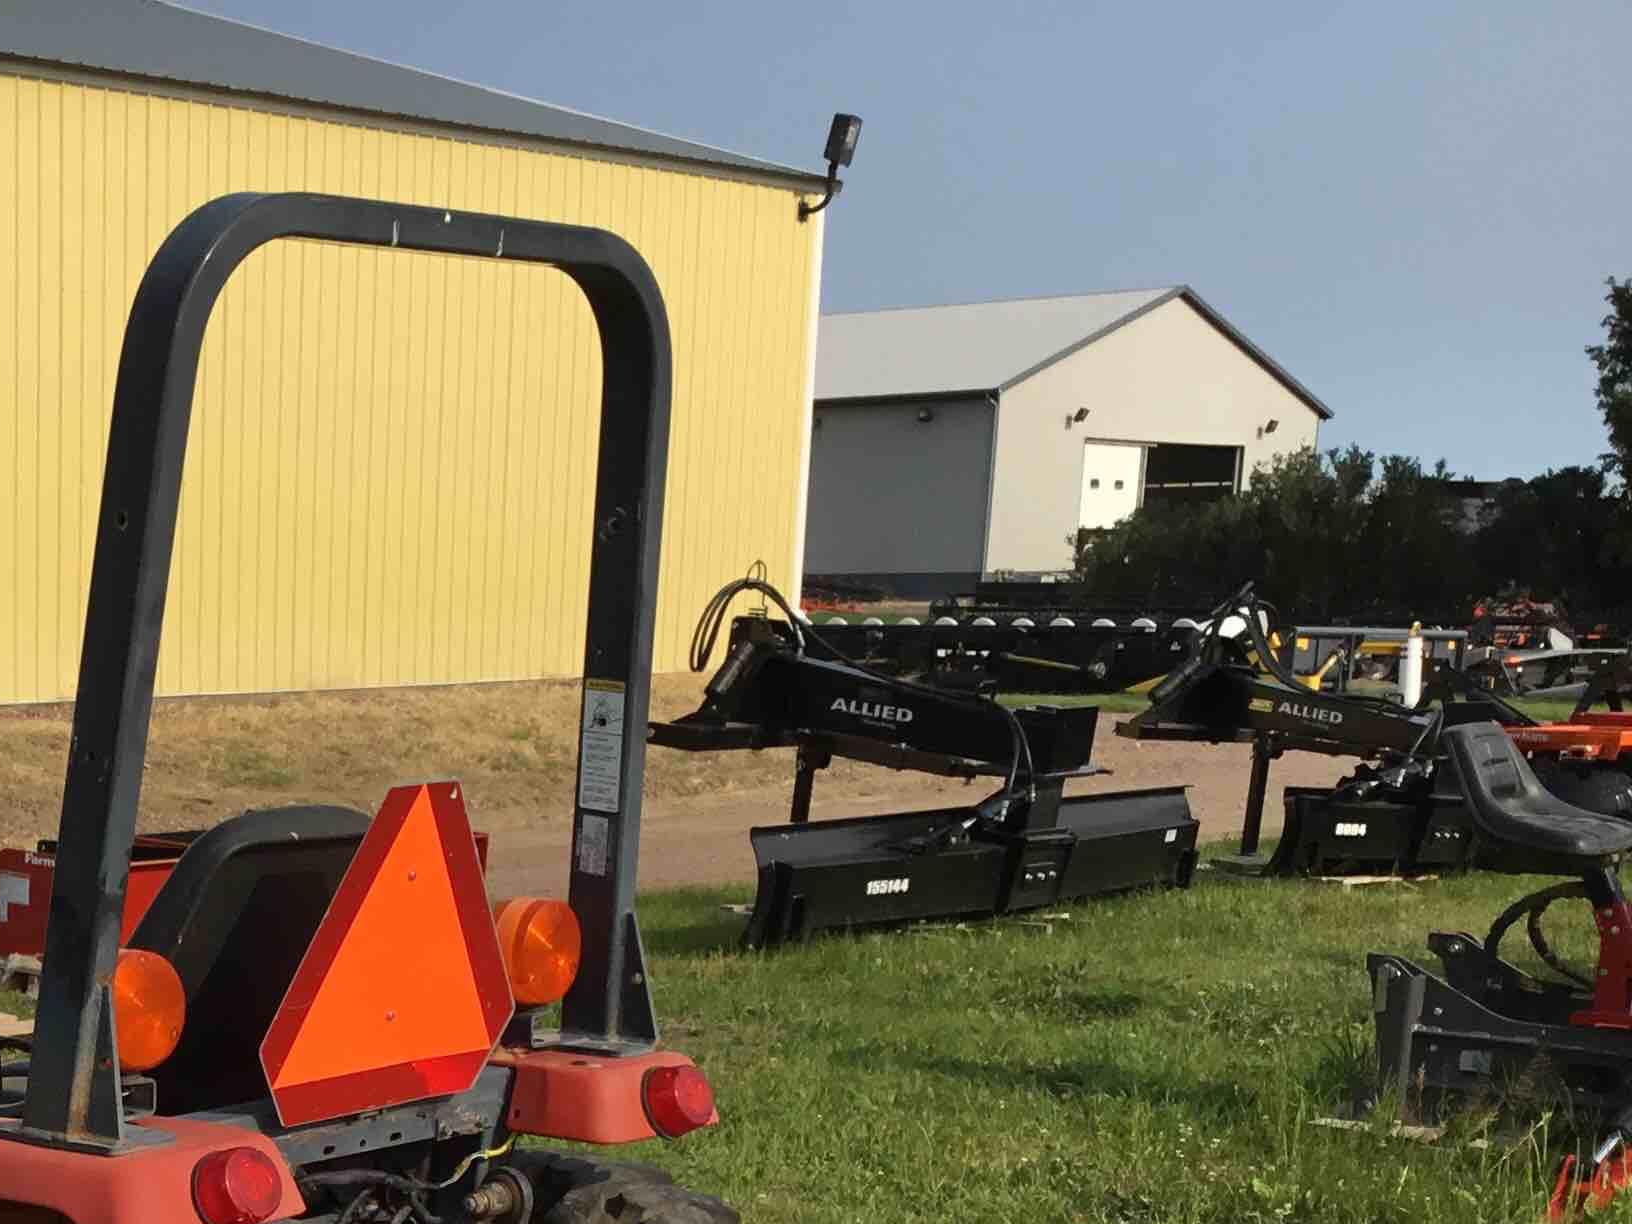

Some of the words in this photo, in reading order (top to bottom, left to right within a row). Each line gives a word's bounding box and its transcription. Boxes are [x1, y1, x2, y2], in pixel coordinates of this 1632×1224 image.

[830, 697, 913, 723] ALLIED
[1278, 702, 1344, 724] ALLIED
[866, 877, 910, 896] 155144
